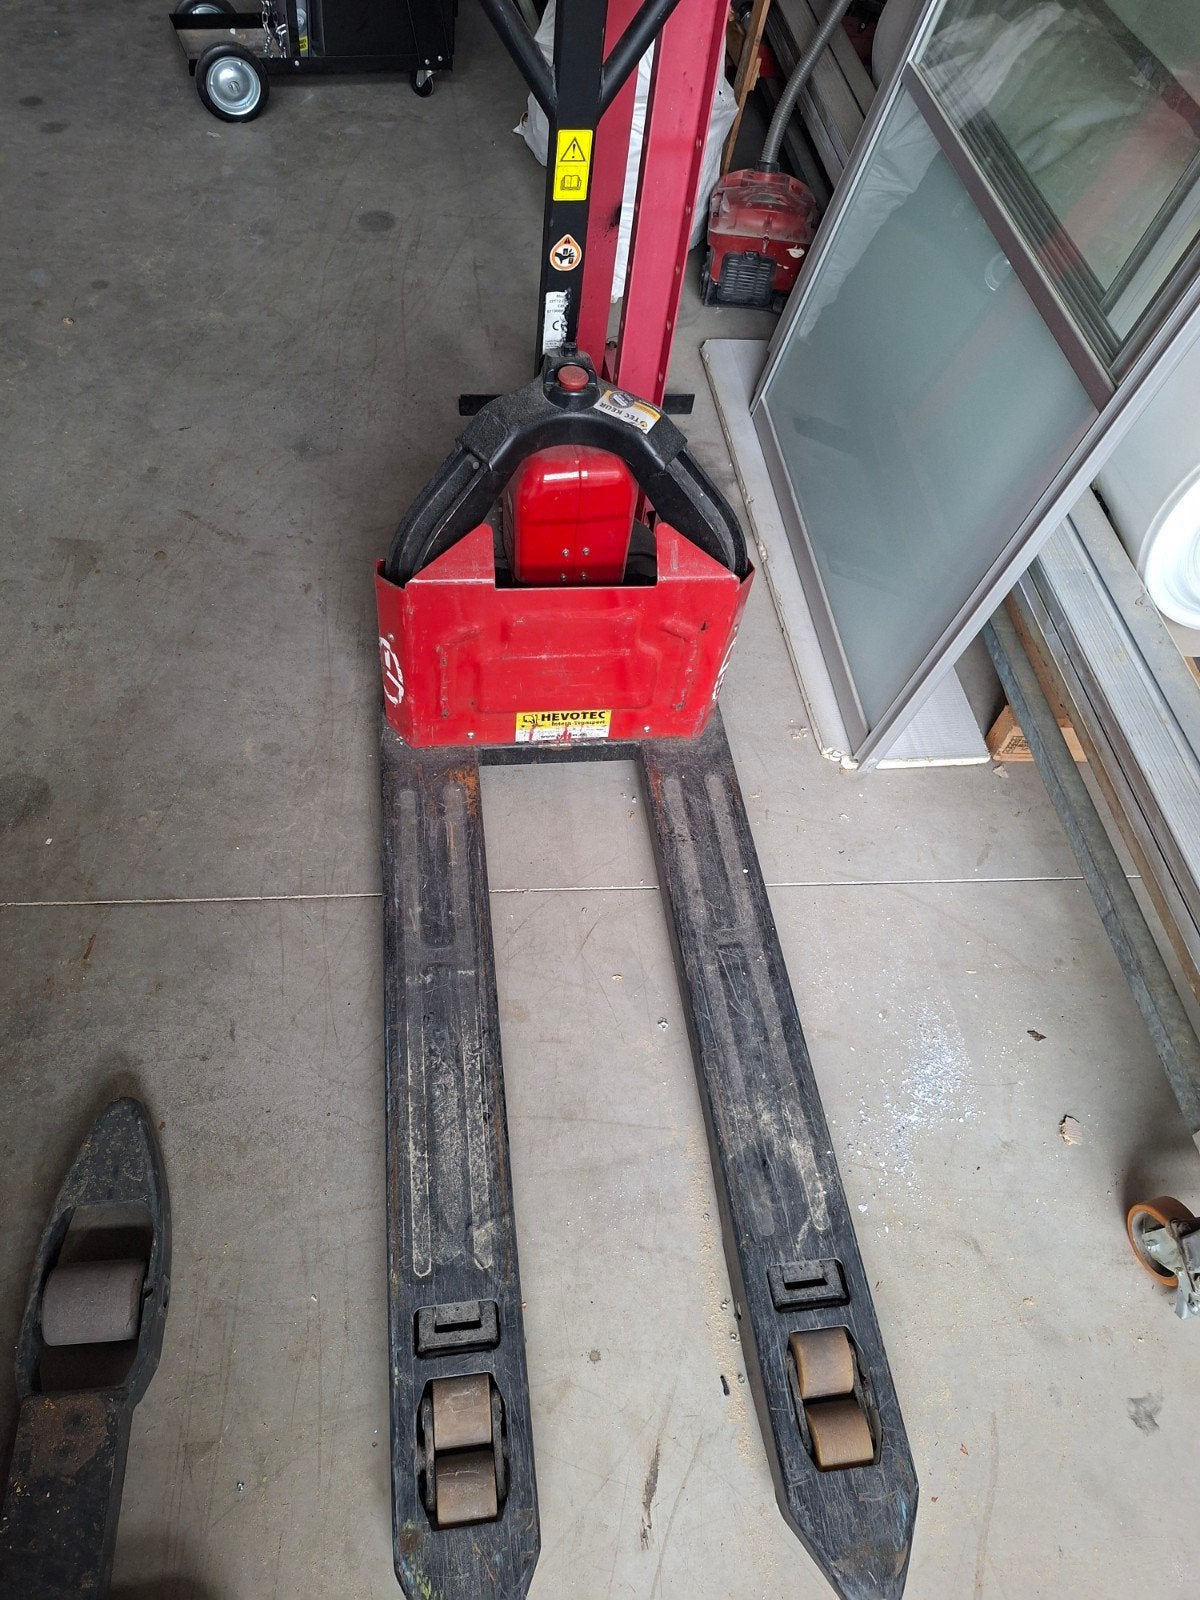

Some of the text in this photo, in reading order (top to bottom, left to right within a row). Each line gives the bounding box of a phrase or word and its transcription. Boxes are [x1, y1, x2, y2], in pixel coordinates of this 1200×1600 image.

[599, 402, 623, 415] KEUR
[624, 412, 640, 423] TEC
[541, 711, 606, 721] HEVOTEC
